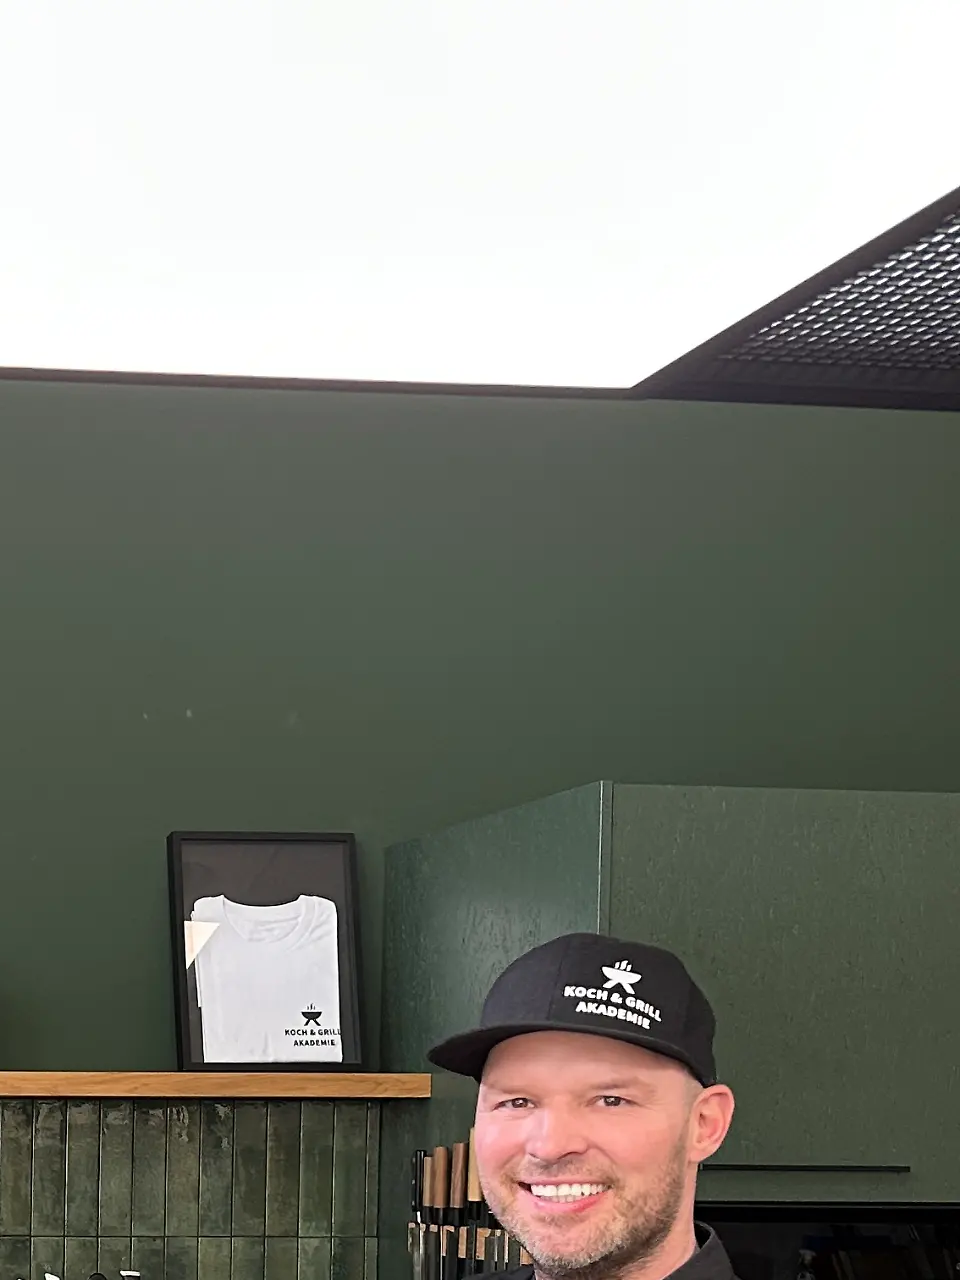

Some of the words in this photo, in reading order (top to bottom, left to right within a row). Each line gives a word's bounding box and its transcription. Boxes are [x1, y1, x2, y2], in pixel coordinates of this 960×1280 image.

[563, 985, 608, 1001] KOCH
[610, 992, 622, 1004] &
[625, 996, 662, 1022] GRILL
[575, 1001, 651, 1030] AKADEMIE
[284, 1028, 308, 1036] KOCH
[293, 1039, 336, 1047] AKADEMIE
